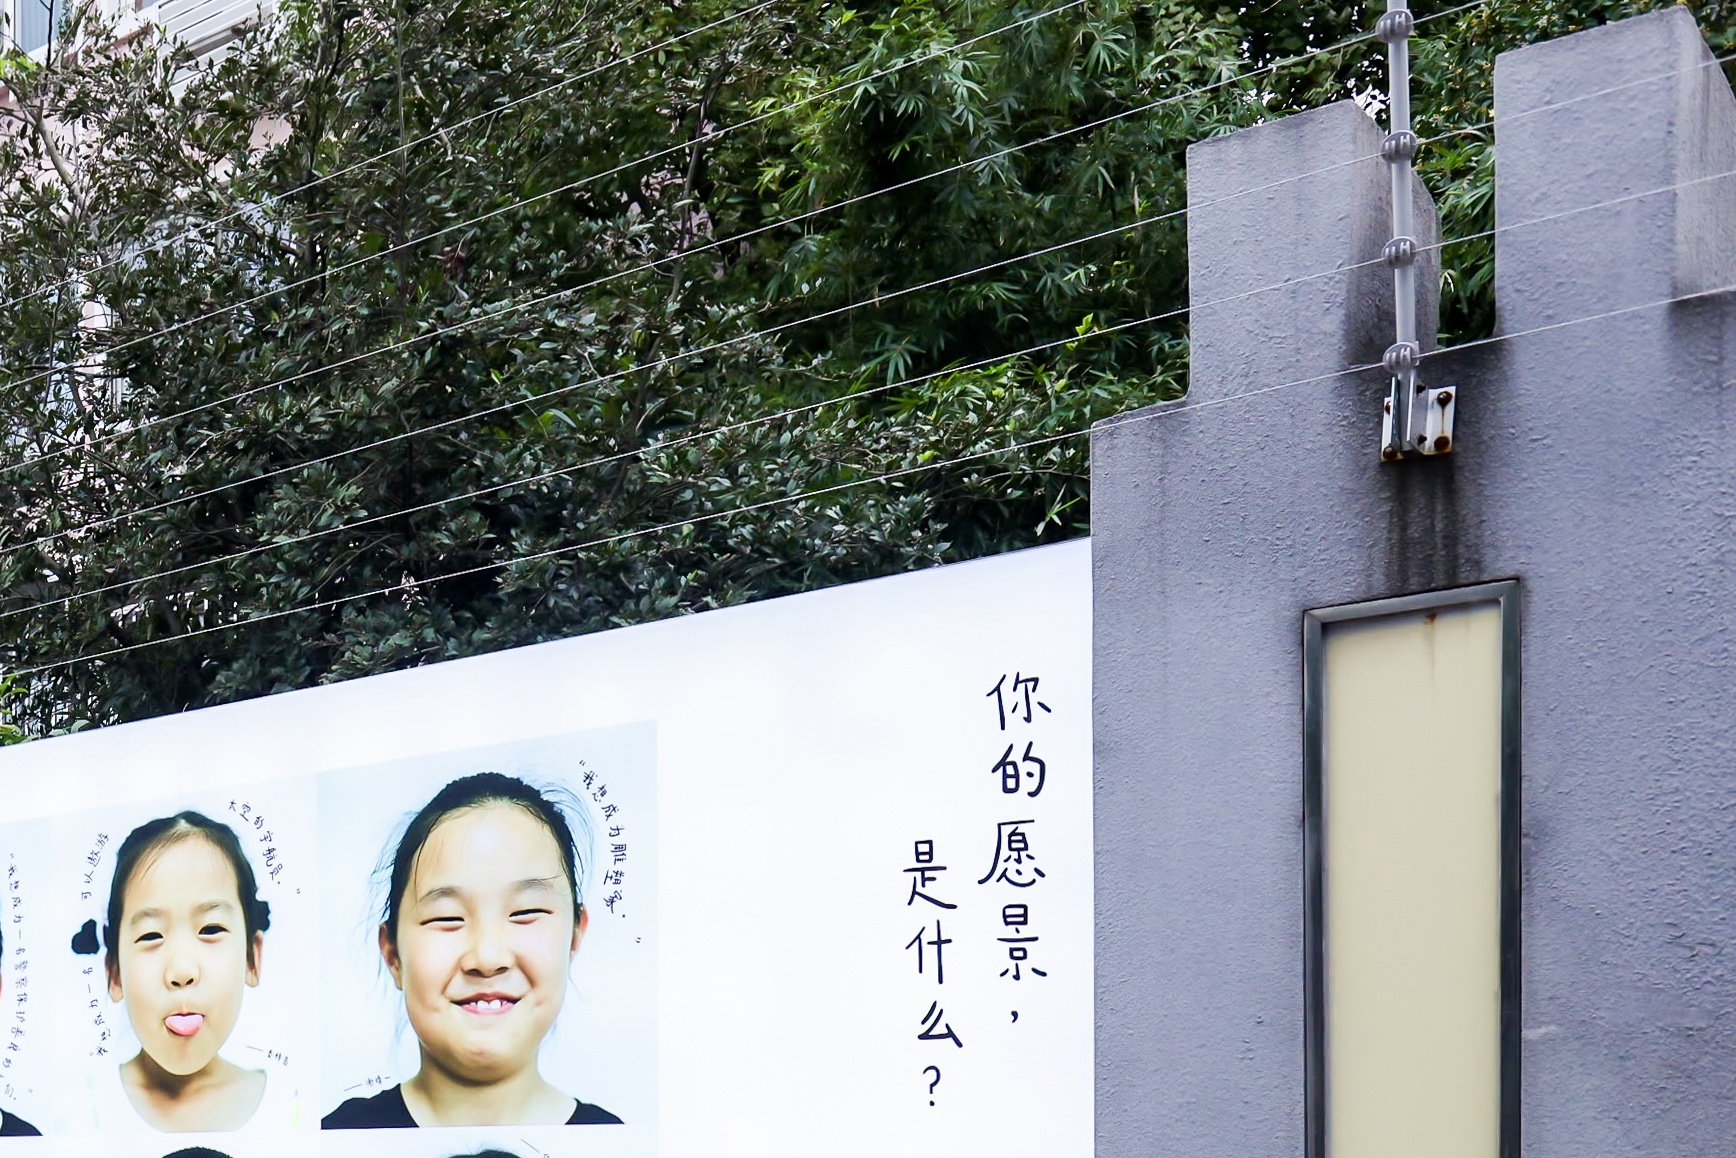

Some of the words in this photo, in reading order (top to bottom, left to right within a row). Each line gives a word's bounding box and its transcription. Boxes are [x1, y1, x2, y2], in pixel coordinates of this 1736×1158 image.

[903, 839, 963, 1107] 是什么？
[978, 671, 1053, 1024] 你的愿景，
